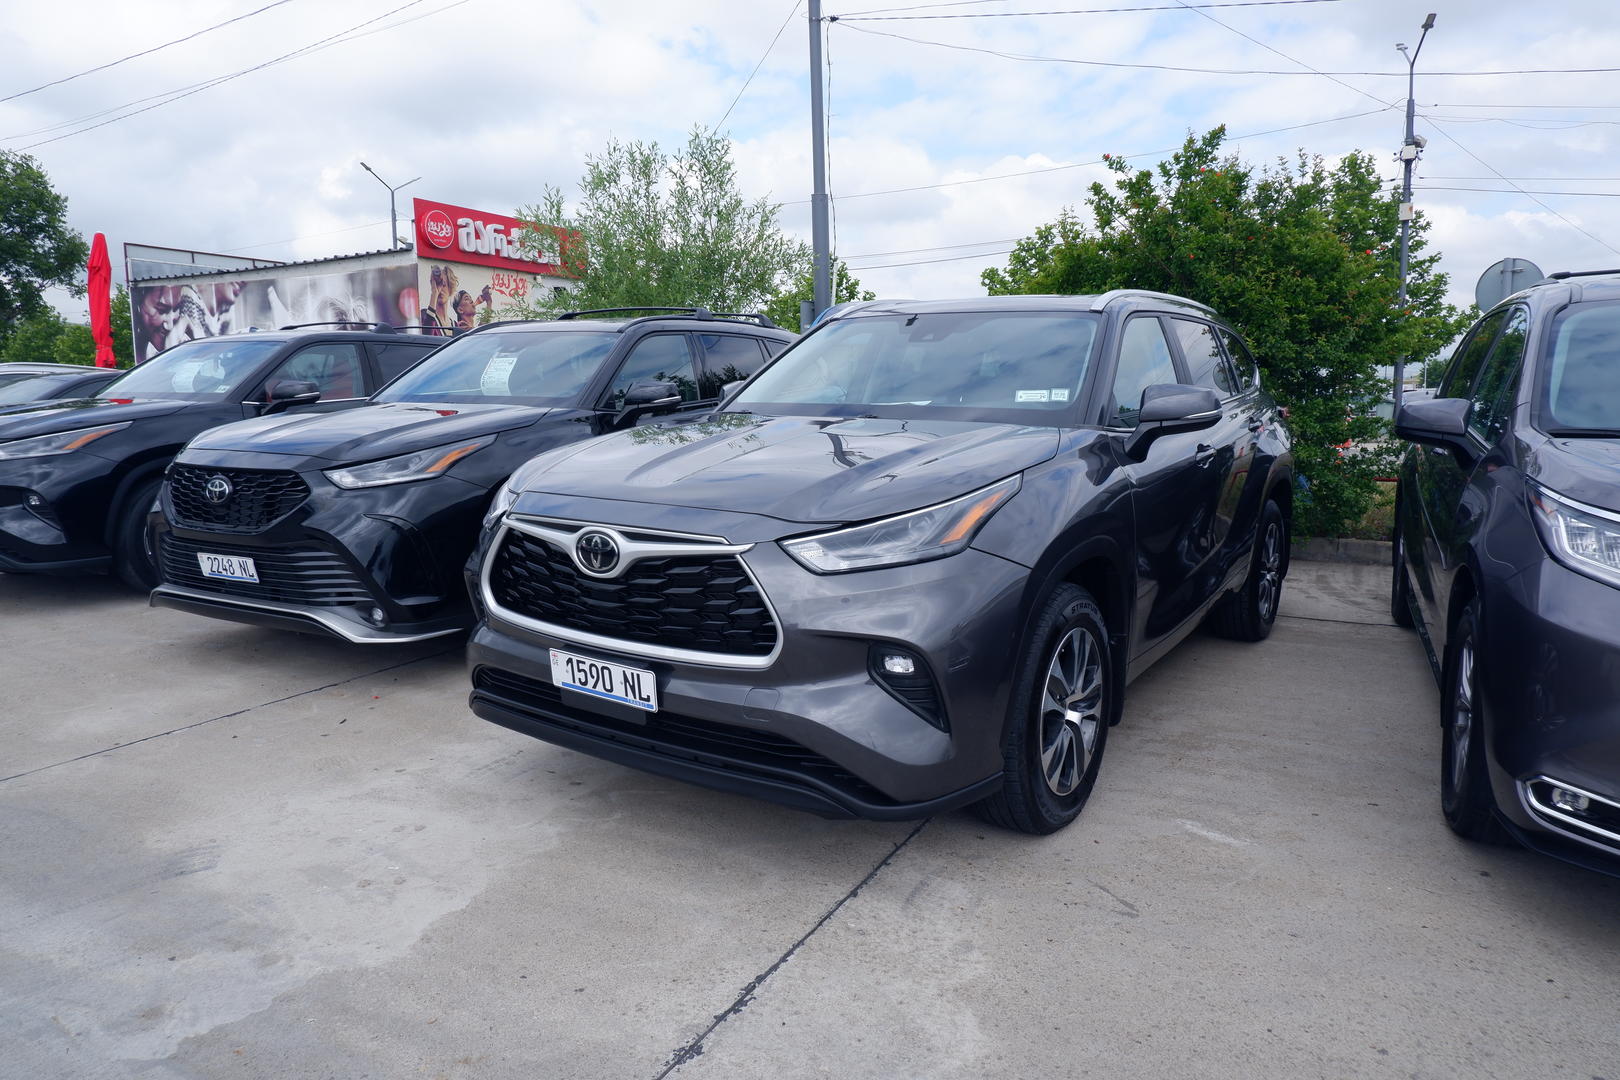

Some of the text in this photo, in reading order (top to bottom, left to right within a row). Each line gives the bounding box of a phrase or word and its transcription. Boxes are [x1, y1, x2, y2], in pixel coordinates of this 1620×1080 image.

[207, 556, 255, 578] 2248 NL
[566, 657, 651, 702] 1590 NL
